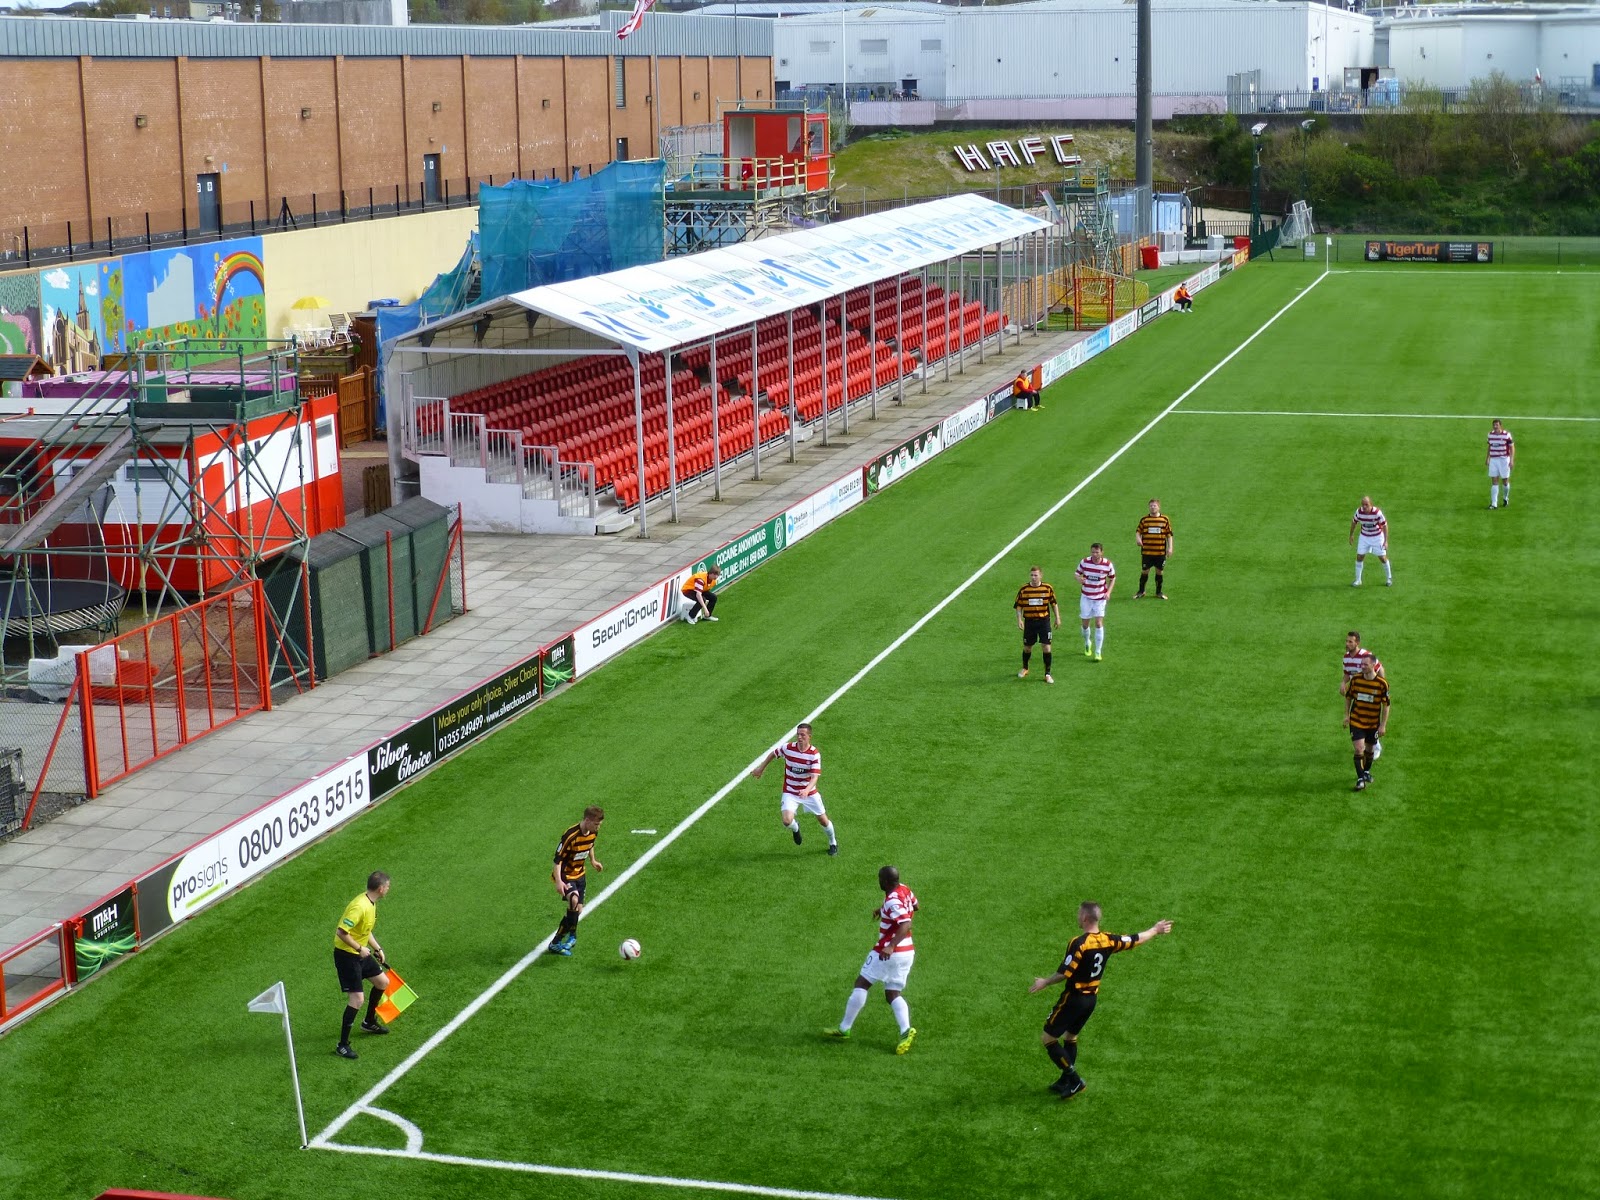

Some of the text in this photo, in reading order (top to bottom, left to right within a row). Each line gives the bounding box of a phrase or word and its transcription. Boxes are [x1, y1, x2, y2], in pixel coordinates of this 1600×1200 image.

[953, 134, 1082, 171] HAFC
[1386, 243, 1440, 256] TigerTurf
[945, 411, 980, 446] CHAMPIONSHIP
[716, 527, 767, 567] COCAINE ANONYMOUS
[739, 556, 750, 572] 0141
[592, 599, 659, 649] SecuriGroup
[438, 710, 457, 731] Make
[456, 703, 471, 724] your
[470, 694, 483, 712] only
[503, 676, 519, 693] Silver
[519, 665, 538, 684] Choice
[438, 683, 538, 752] 01355 249499 www.silverchoice.co.uk
[371, 741, 410, 775] Silver
[398, 750, 432, 781] Choice
[238, 769, 364, 869] 0800 633 5515
[172, 856, 228, 908] prosigns
[93, 903, 118, 933] M&H
[94, 921, 119, 940] LOGISTICS
[1090, 952, 1104, 978] 3
